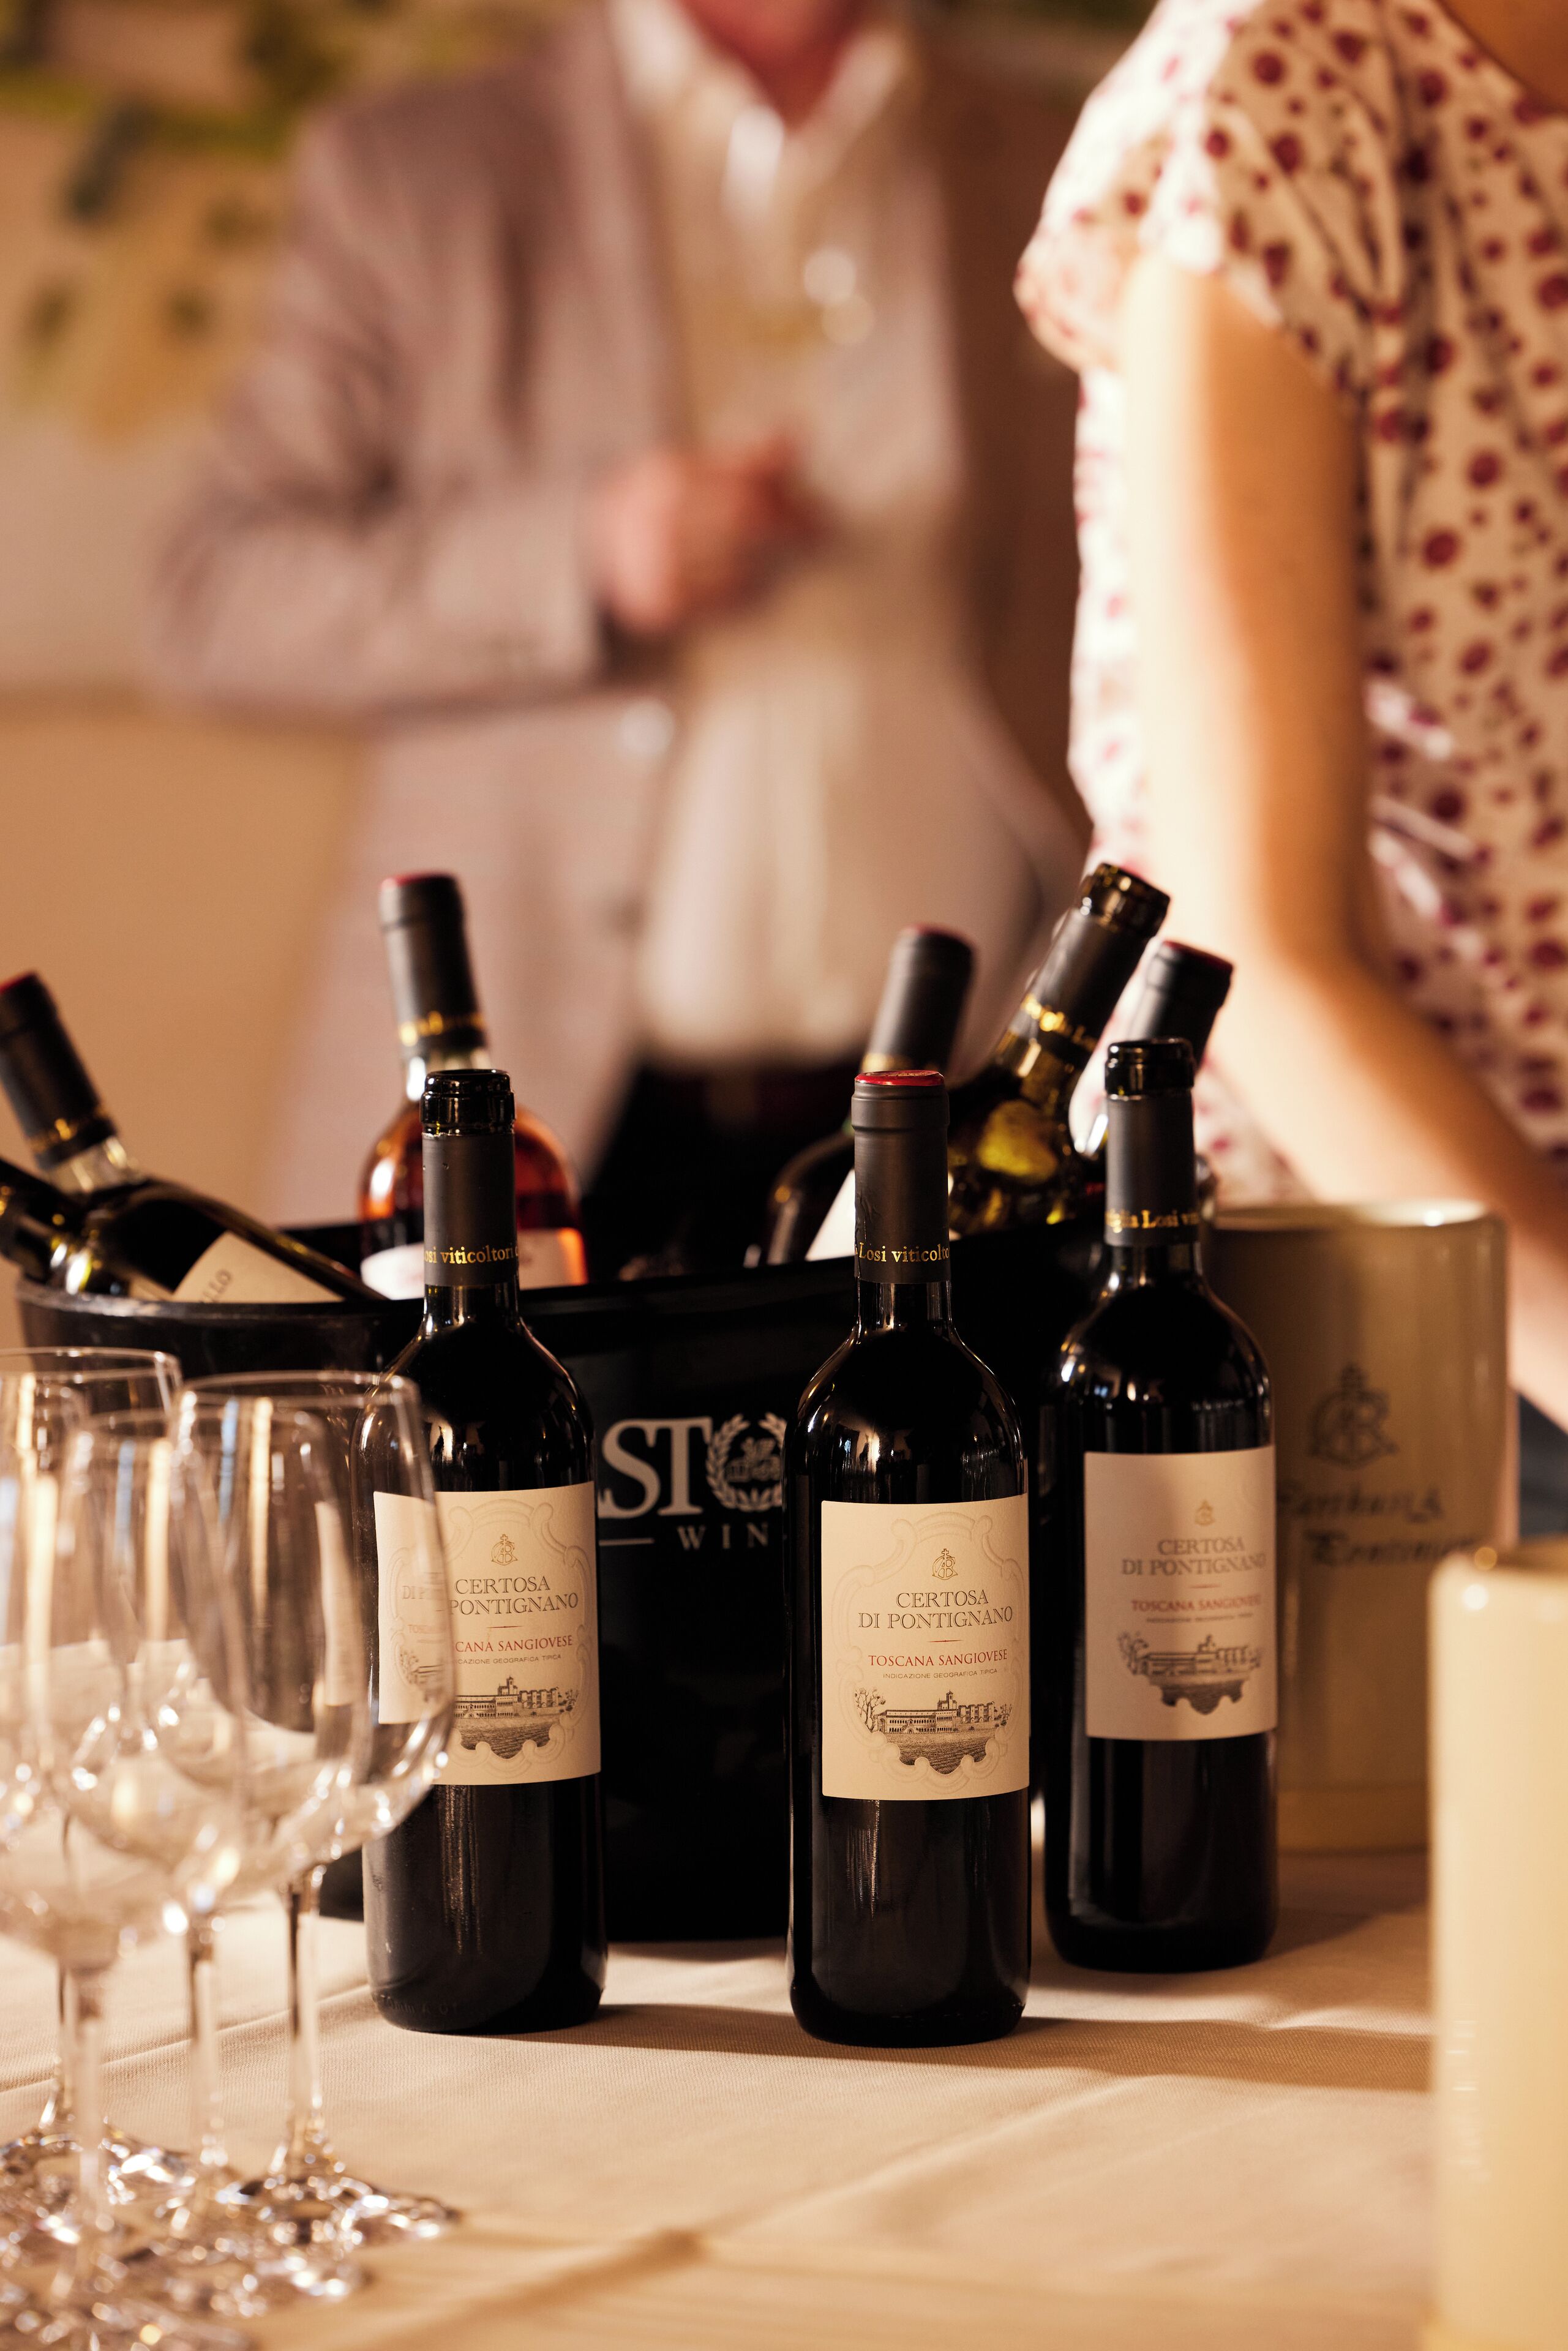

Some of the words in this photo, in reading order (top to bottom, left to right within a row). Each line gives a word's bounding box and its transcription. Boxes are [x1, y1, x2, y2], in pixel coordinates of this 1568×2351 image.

[424, 1247, 437, 1264] osi
[859, 1242, 887, 1262] Losi
[1158, 1537, 1245, 1555] CERTOSA
[1122, 1559, 1143, 1575] DI
[456, 1576, 550, 1594] CERTOSA
[449, 1592, 579, 1615] PONTIGNANO
[896, 1589, 989, 1608] CERTOSA
[858, 1613, 880, 1629] DI
[887, 1606, 1013, 1629] PONTIGNANO
[455, 1640, 493, 1652] CANA
[498, 1635, 573, 1652] SANGIOVESE
[868, 1655, 934, 1667] TOSCANA
[939, 1649, 1008, 1666] SANGIOVESE
